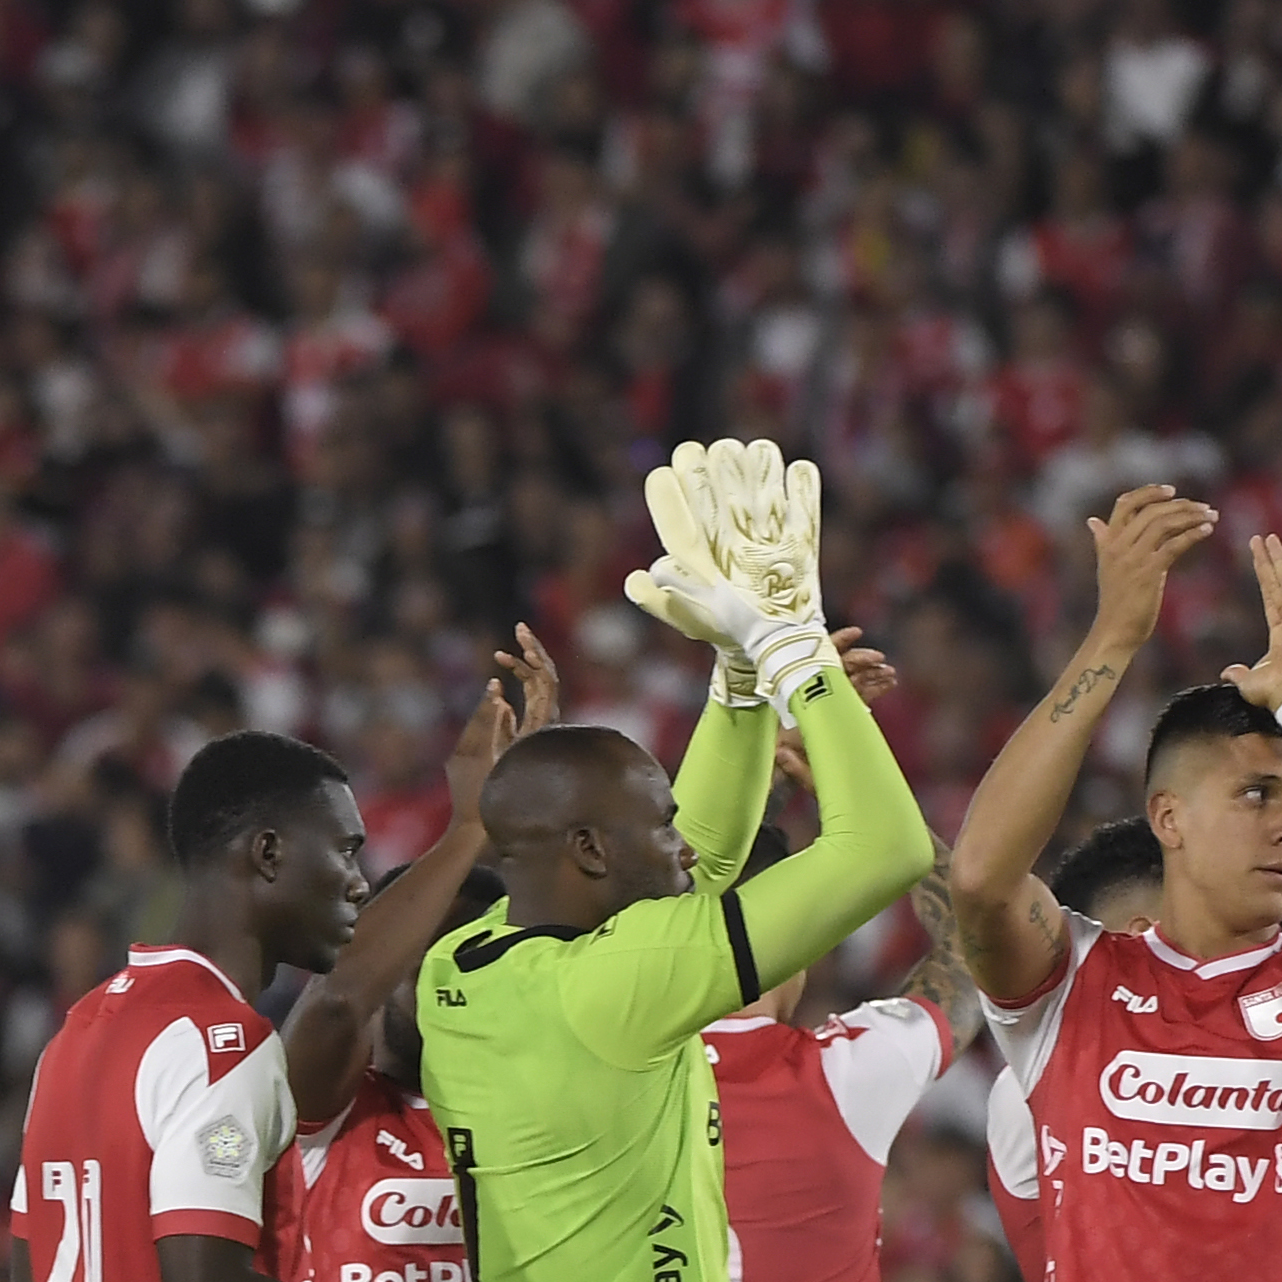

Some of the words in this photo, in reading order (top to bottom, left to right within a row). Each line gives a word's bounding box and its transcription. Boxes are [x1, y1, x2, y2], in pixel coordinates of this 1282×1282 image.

[435, 988, 467, 1007] FILA
[1112, 985, 1159, 1014] FILA
[376, 1129, 425, 1171] FILA
[1082, 1126, 1270, 1204] BetPlay
